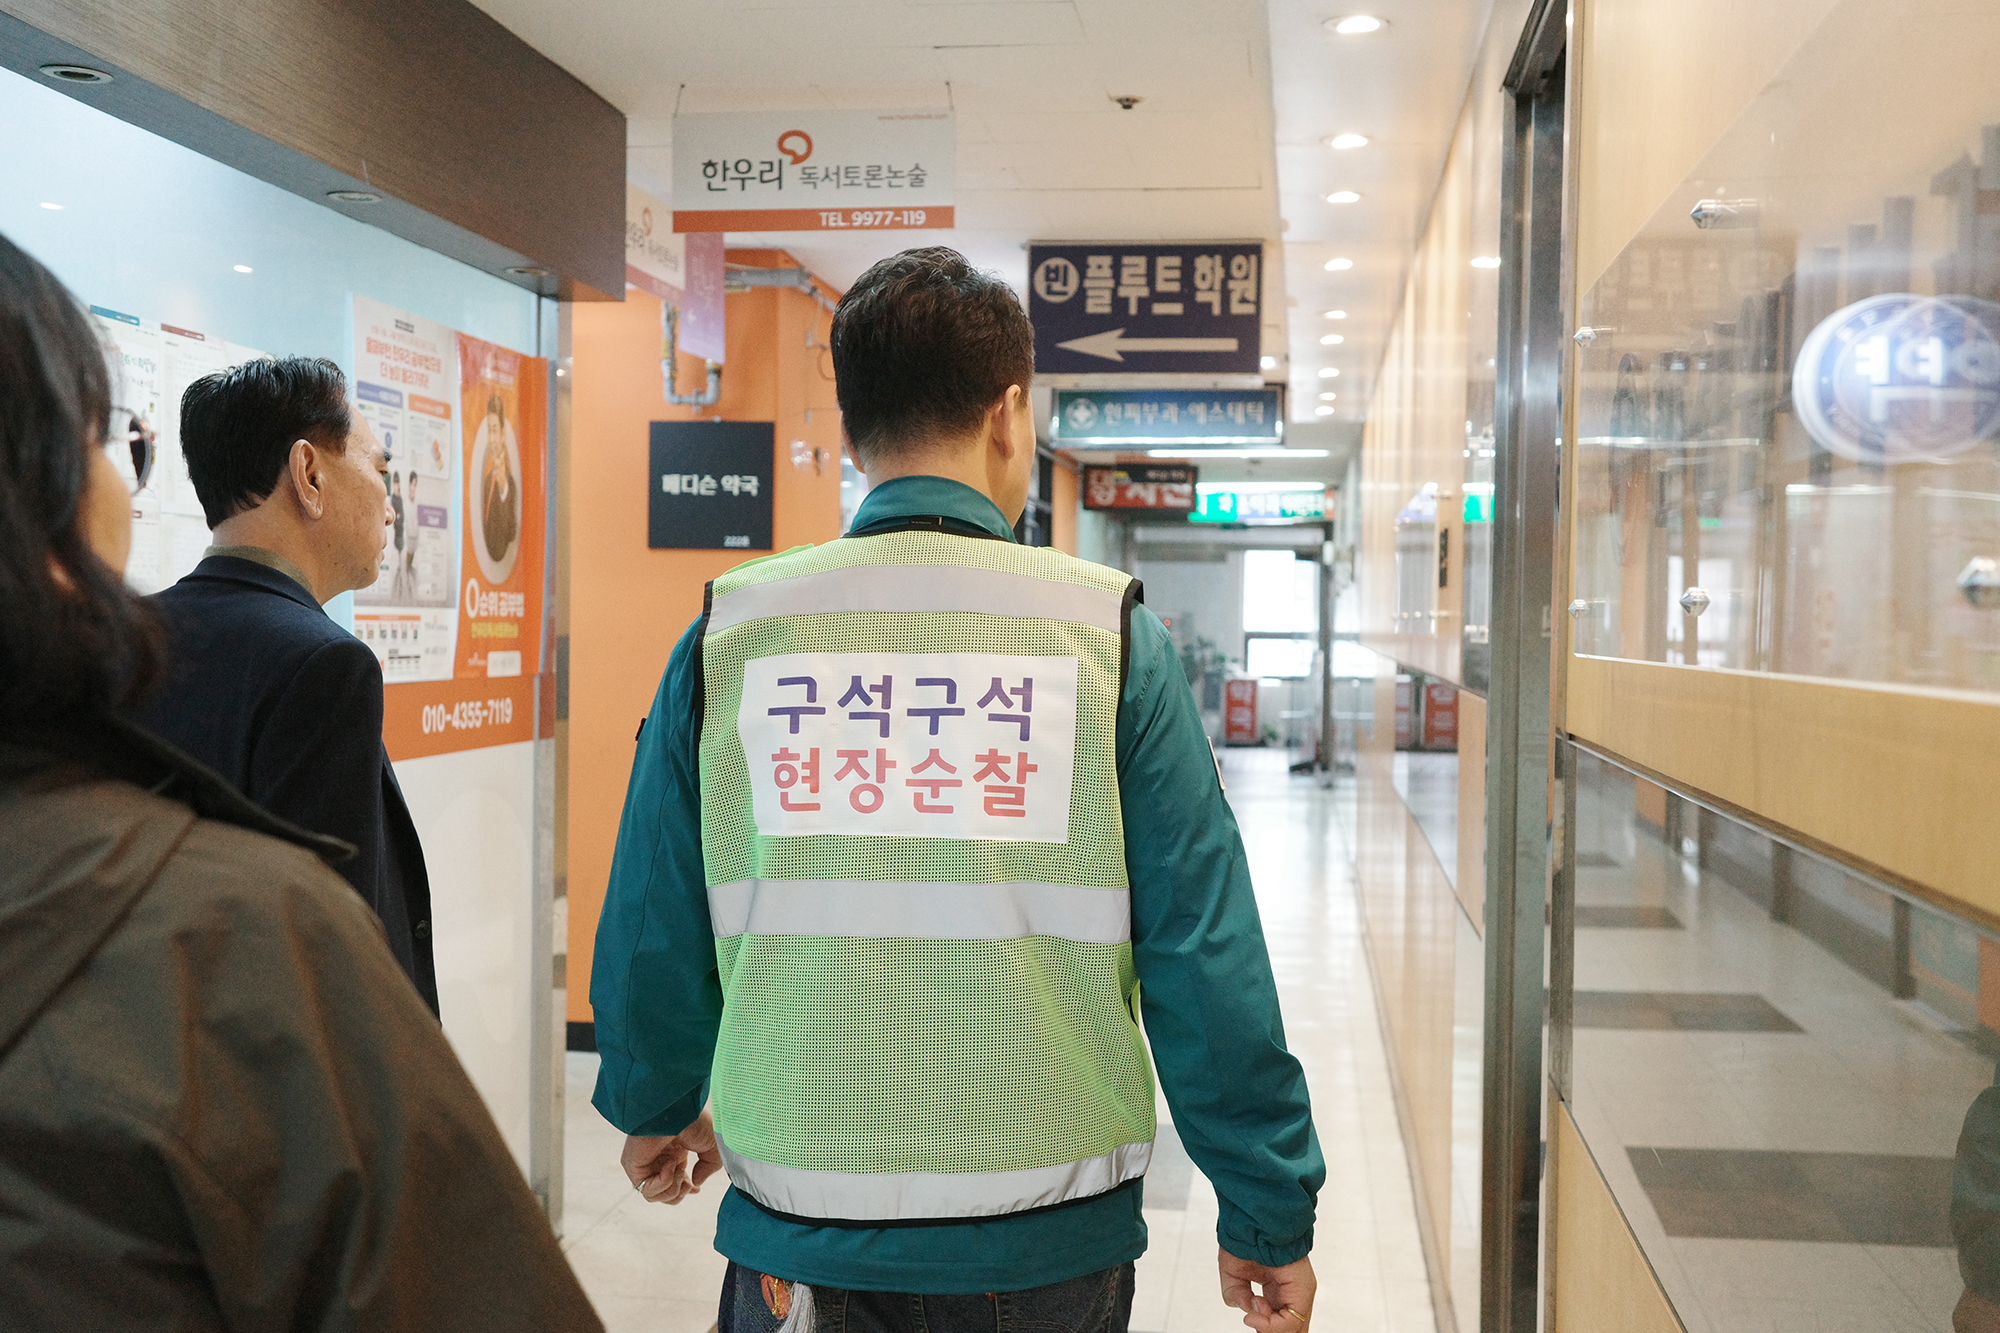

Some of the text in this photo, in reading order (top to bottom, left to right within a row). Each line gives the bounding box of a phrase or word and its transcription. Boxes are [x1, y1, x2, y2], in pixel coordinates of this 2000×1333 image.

[702, 158, 927, 192] 한우리 독서토론논술
[1083, 254, 1185, 316] 플루트
[1193, 253, 1258, 316] 학원
[721, 474, 759, 497] 약국
[421, 697, 513, 735] 010-4355-7119
[767, 674, 1034, 742] 구석구석
[770, 746, 1038, 818] 현장순찰
